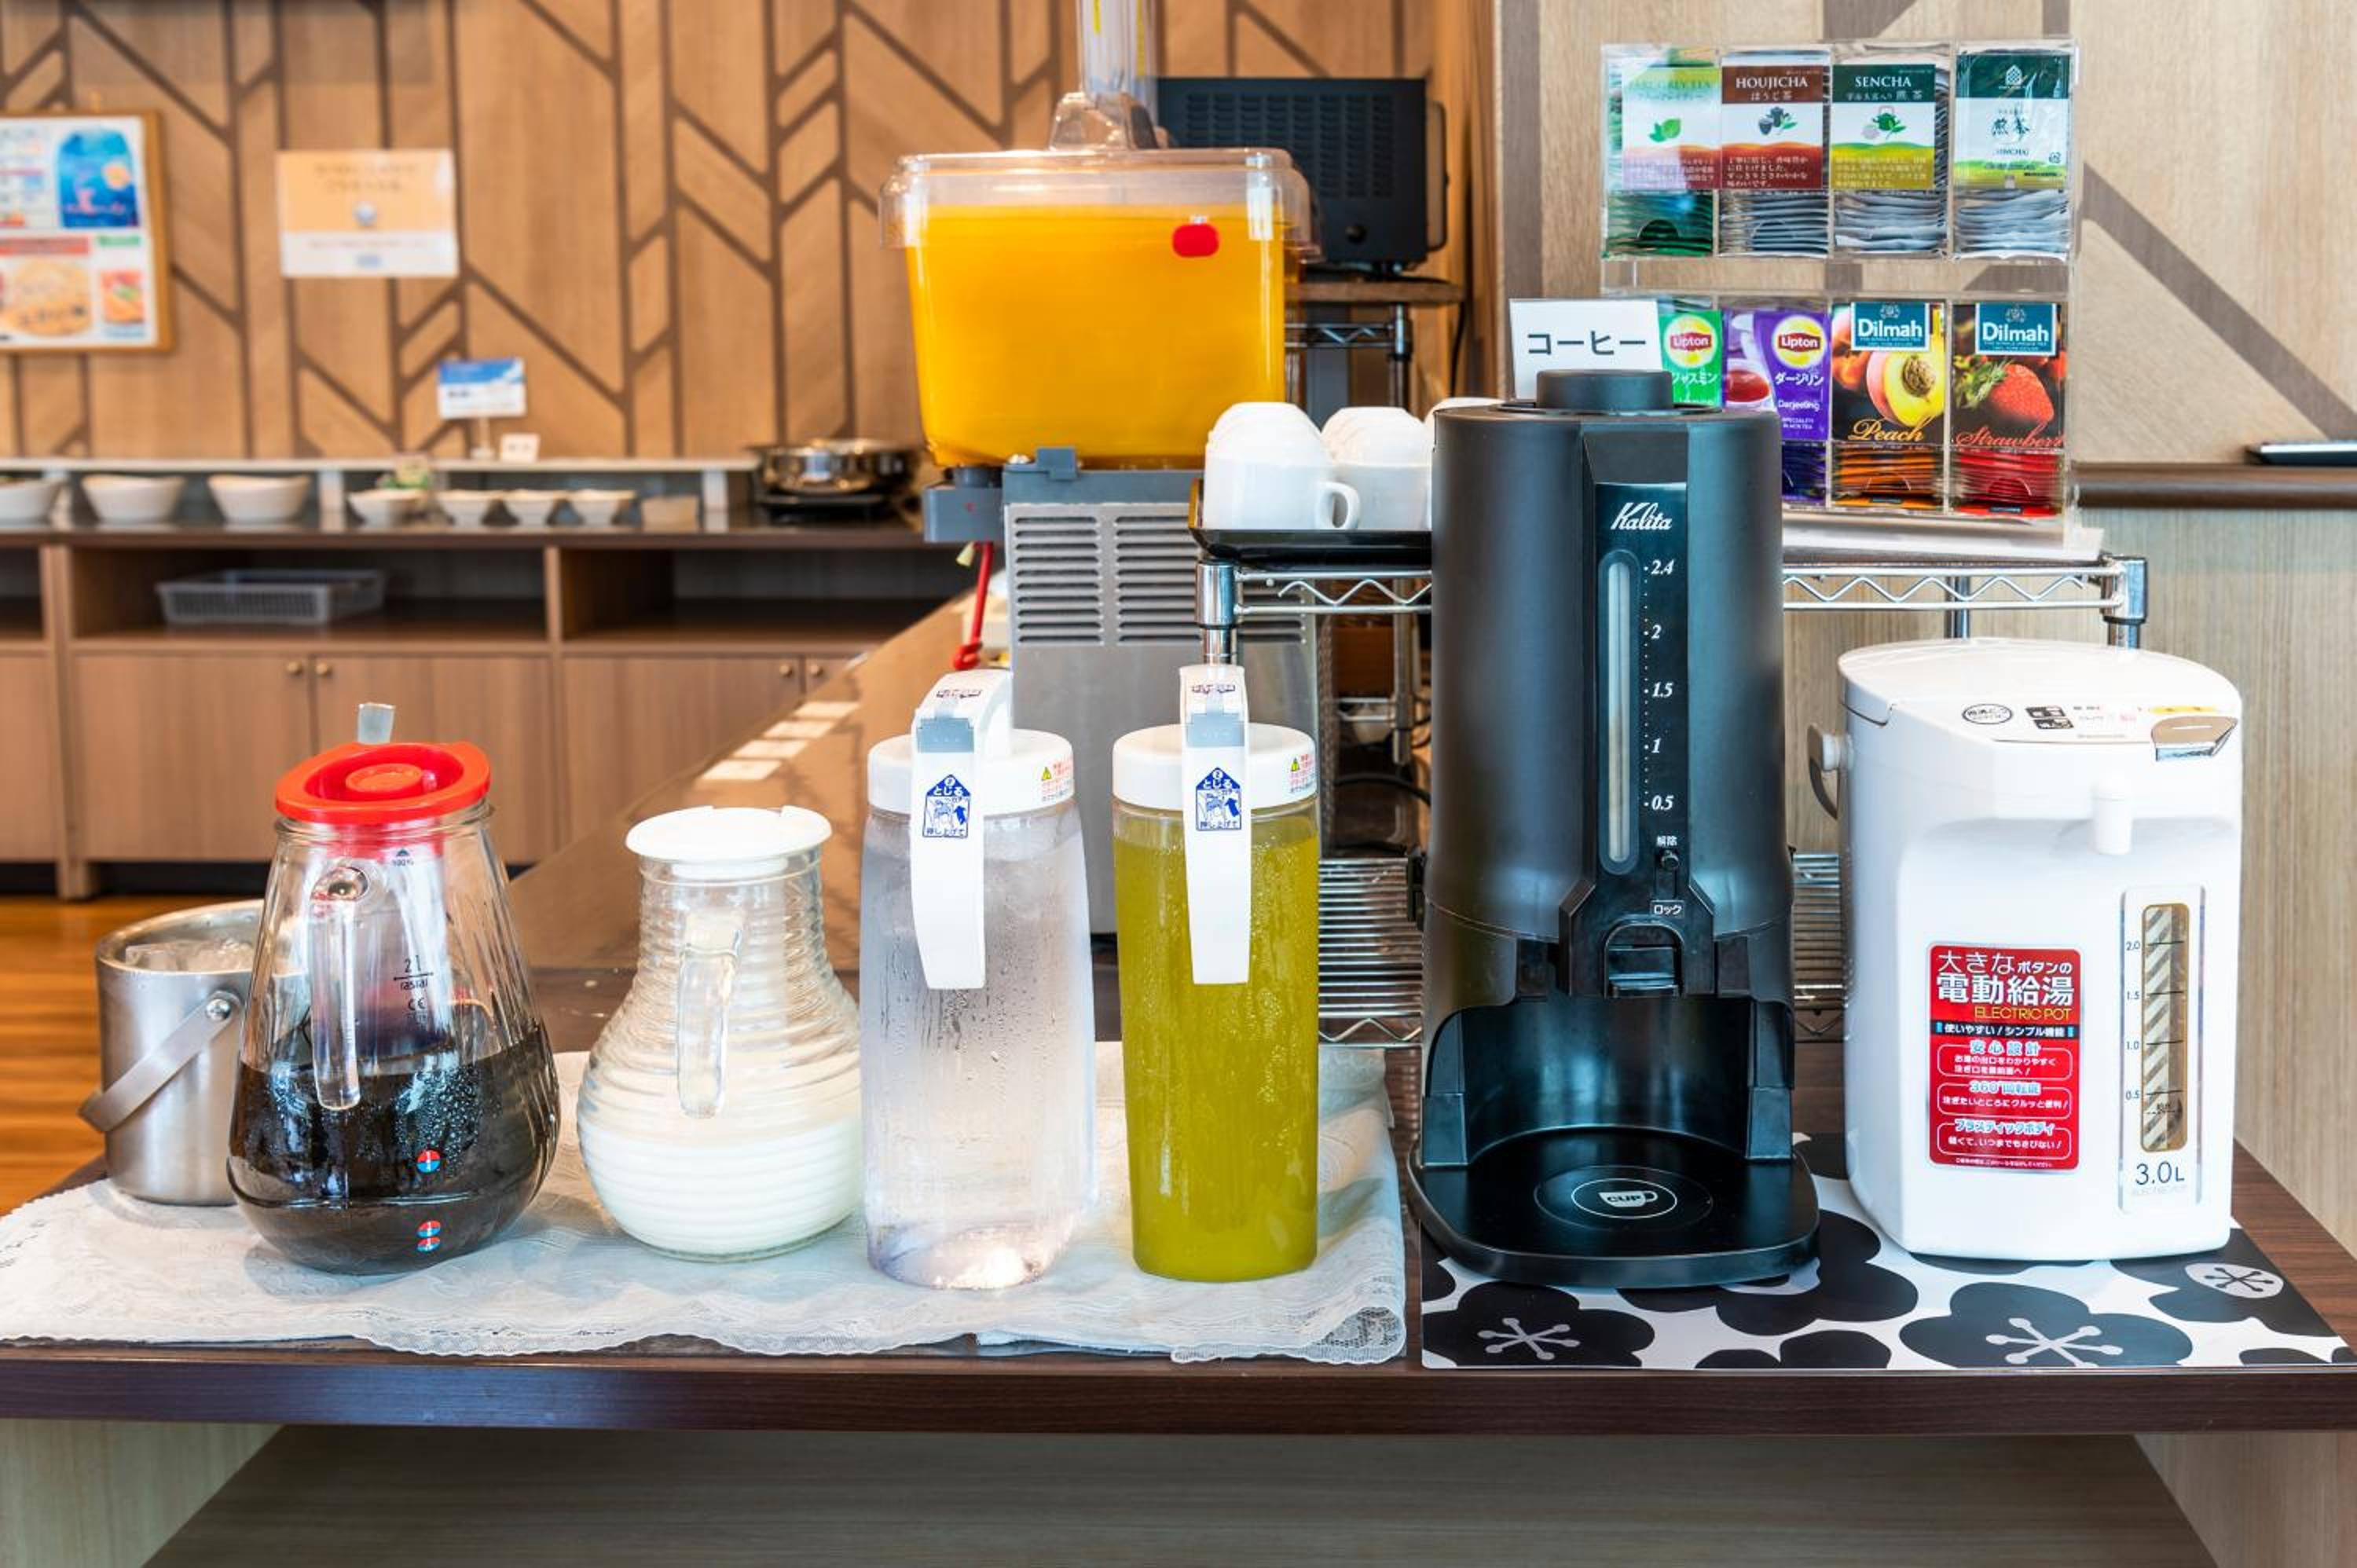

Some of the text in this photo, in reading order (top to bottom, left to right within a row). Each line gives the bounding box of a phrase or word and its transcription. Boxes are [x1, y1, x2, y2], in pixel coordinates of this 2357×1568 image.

[1735, 76, 1809, 90] HOUJICHA
[1854, 75, 1912, 88] SENCHA
[1857, 318, 1923, 337] Dilmah
[1981, 322, 2050, 342] Dilmah
[1527, 330, 1647, 356] コーヒー
[1673, 336, 1710, 349] Lipton
[1781, 336, 1819, 348] Lipton
[1775, 372, 1824, 387] ダージリン
[1847, 416, 1935, 441] Peach
[1955, 422, 2065, 447] Strawberr
[1610, 502, 1673, 531] Kalita
[1651, 559, 1675, 575] 2.4
[1651, 625, 1662, 639] 2
[1651, 682, 1673, 698] 1.5
[1651, 738, 1662, 753] 1
[933, 786, 964, 796] とじる
[1204, 779, 1233, 789] とじる
[1651, 795, 1674, 811] 0.5
[1654, 904, 1683, 915] ロック
[2126, 940, 2141, 951] 2.0
[1937, 950, 2073, 975] 大きなボタンの
[1936, 973, 2075, 1006] 電動給湯
[2126, 991, 2140, 1001] 1.5
[1974, 1006, 2073, 1021] ELECTRIC POT
[1970, 1040, 2041, 1056] 安心設計
[2126, 1040, 2139, 1050] 1.0
[2125, 1090, 2140, 1101] 0.5
[2135, 1160, 2186, 1185] 3.0L
[1607, 1194, 1642, 1203] CUP
